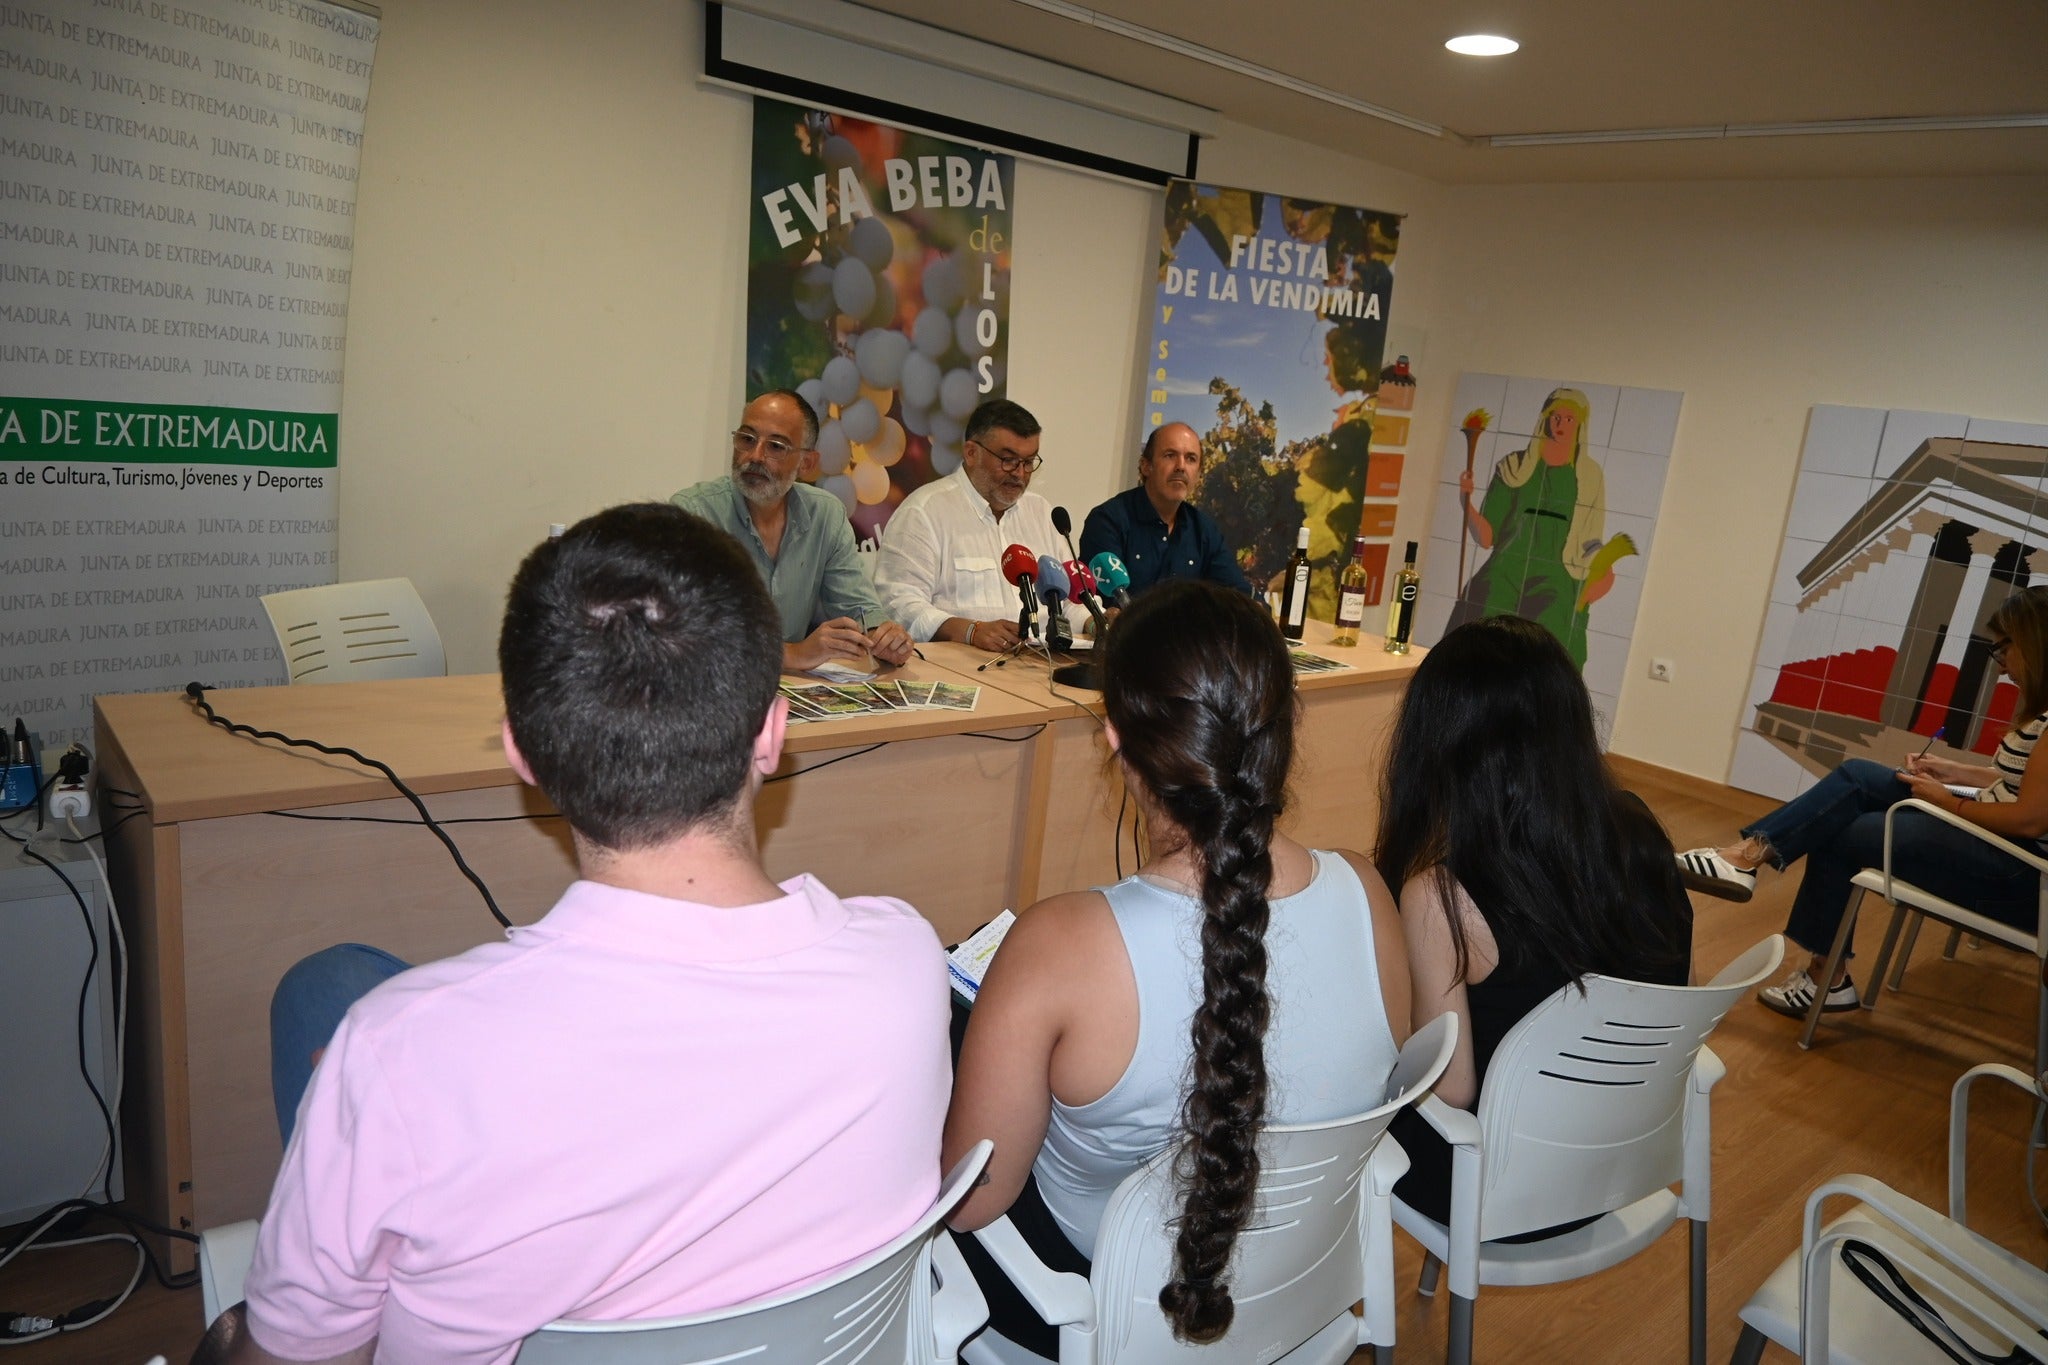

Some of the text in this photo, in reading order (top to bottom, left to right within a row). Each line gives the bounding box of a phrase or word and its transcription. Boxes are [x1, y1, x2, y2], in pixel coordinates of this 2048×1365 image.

[0, 5, 368, 114] JUNTA DE EXTREMADURA JUNTA DE EXTREMADURA
[150, 2, 168, 23] DE
[173, 8, 281, 54] EXTREMADURA
[289, 39, 325, 66] JUNTA
[328, 52, 344, 71] DE
[91, 71, 144, 99] JUNTA
[149, 83, 167, 104] DE
[171, 89, 280, 129] EXTREMADURA
[291, 115, 328, 140] JUNTA
[331, 126, 344, 144] DE
[60, 105, 79, 126] DE
[84, 111, 199, 151] EXTREMADURA
[211, 136, 258, 162] JUNTA
[263, 147, 281, 167] DE
[91, 153, 143, 180] JUNTA
[149, 164, 166, 184] DE
[170, 168, 279, 203] EXTREMADURA
[285, 189, 324, 212] JUNTA
[327, 197, 339, 214] DE
[762, 156, 1006, 249] EVA BEBA
[57, 188, 77, 208] DE
[82, 192, 197, 227] EXTREMADURA
[208, 213, 256, 237] JUNTA
[260, 221, 277, 240] DE
[969, 215, 1004, 255] de
[88, 232, 139, 257] JUNTA
[144, 241, 161, 260] DE
[166, 244, 274, 275] EXTREMADURA
[285, 261, 324, 282] JUNTA
[1229, 234, 1330, 282] FIESTA
[56, 269, 76, 289] DE
[81, 272, 194, 301] EXTREMADURA
[206, 287, 253, 308] JUNTA
[257, 293, 274, 311] DE
[1164, 264, 1382, 322] DE LA VENDIMIA
[84, 312, 137, 333] JUNTA
[142, 317, 159, 335] DE
[163, 319, 270, 346] EXTREMADURA
[278, 331, 318, 351] JUNTA
[55, 348, 74, 366] DE
[79, 350, 192, 374] EXTREMADURA
[203, 359, 250, 379] JUNTA
[254, 364, 272, 381] DE
[40, 408, 81, 445] DE
[95, 410, 329, 454] EXTREMADURA
[15, 466, 35, 485] de
[42, 466, 110, 487] Cultura,
[112, 467, 178, 487] Turismo,
[181, 467, 238, 490] Jóvenes
[243, 474, 252, 491] y
[257, 470, 324, 493] Deportes
[52, 520, 70, 536] DE
[76, 520, 186, 536] EXTREMADURA
[198, 518, 243, 535] JUNTA
[248, 519, 265, 535] DE
[80, 554, 130, 574] JUNTA
[135, 554, 152, 570] DE
[157, 551, 261, 569] EXTREMADURA
[268, 551, 311, 568] JUNTA
[313, 550, 328, 566] DE
[51, 591, 69, 608] DE
[75, 586, 184, 607] EXTREMADURA
[196, 584, 241, 602] JUNTA
[79, 623, 129, 644] JUNTA
[134, 622, 151, 638] DE
[155, 616, 258, 637] EXTREMADURA
[50, 660, 68, 678] DE
[73, 652, 182, 676] EXTREMADURA
[193, 649, 238, 667] JUNTA
[243, 647, 260, 664] DE
